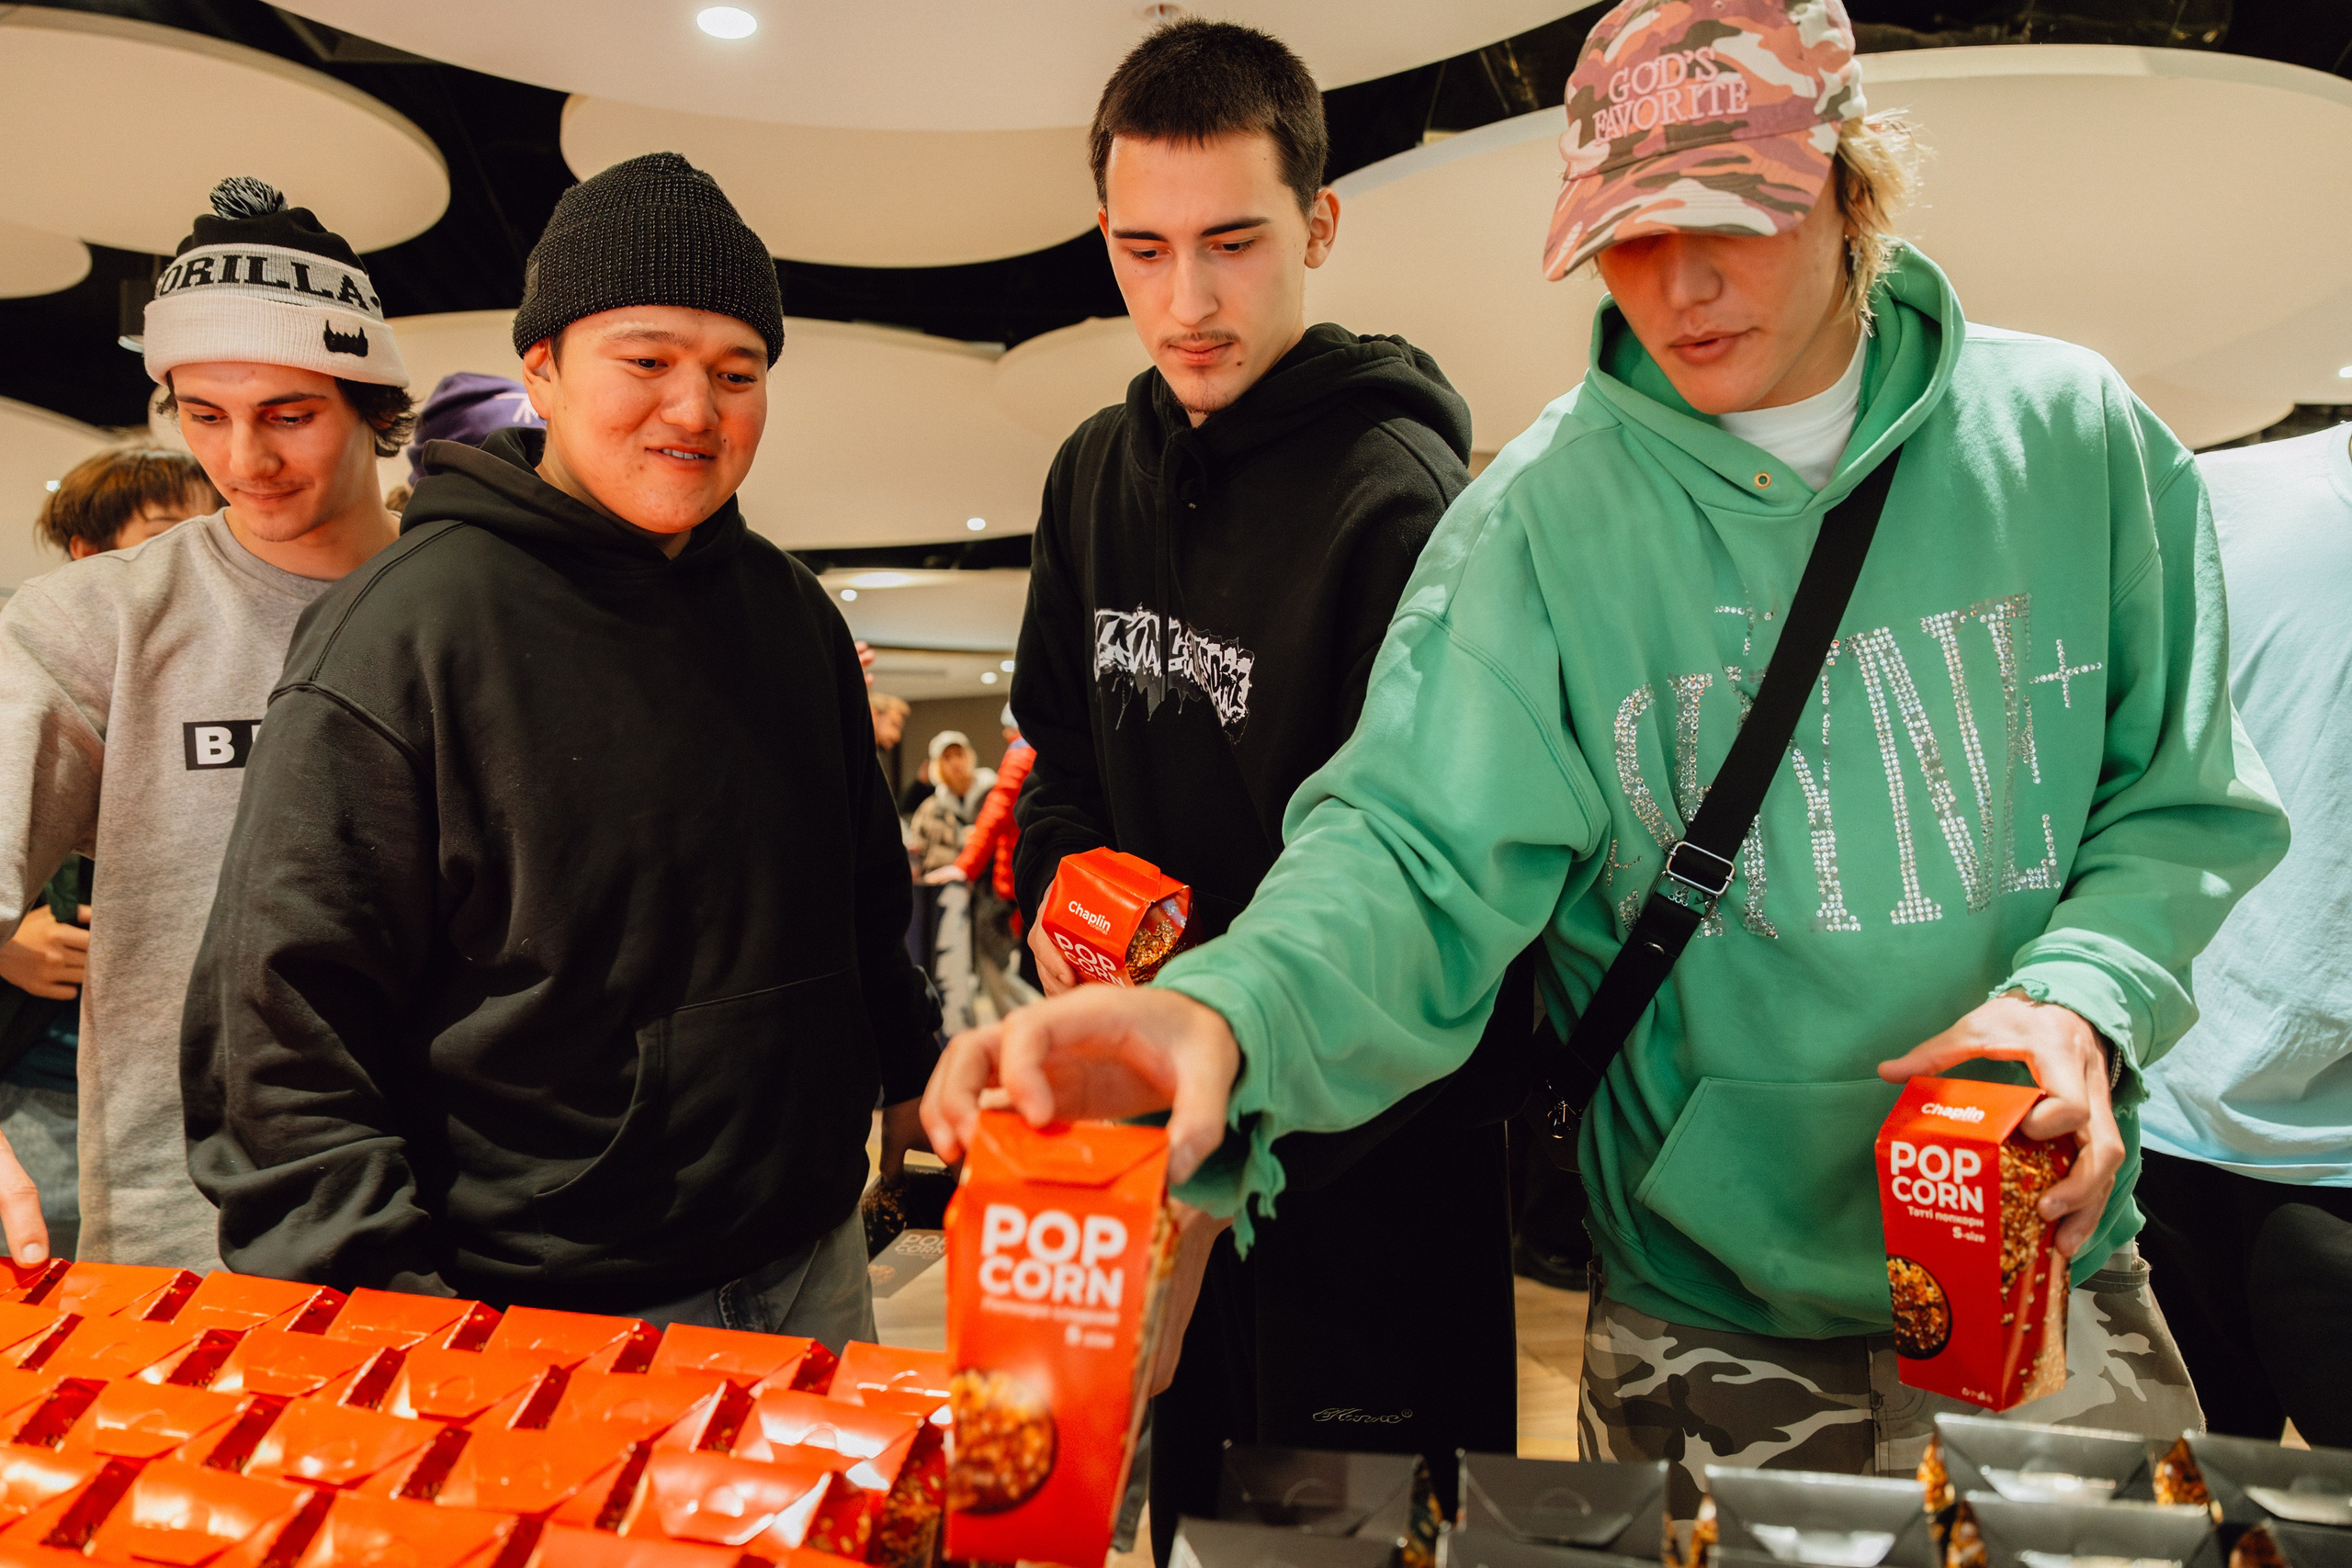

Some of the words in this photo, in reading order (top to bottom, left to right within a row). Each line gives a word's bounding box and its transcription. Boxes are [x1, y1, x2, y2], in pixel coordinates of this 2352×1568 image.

[1608, 46, 1719, 104] GOD'S
[1592, 79, 1749, 147] FAVORITE
[194, 724, 261, 765] B
[1068, 900, 1112, 932] Chaplin
[1054, 931, 1116, 972] POP
[1064, 951, 1127, 988] CORN
[1920, 1102, 1985, 1122] Chaplin
[1890, 1140, 1982, 1185] POP
[1891, 1175, 1984, 1213] CORN
[980, 1203, 1128, 1268] POP
[978, 1254, 1125, 1308] CORN
